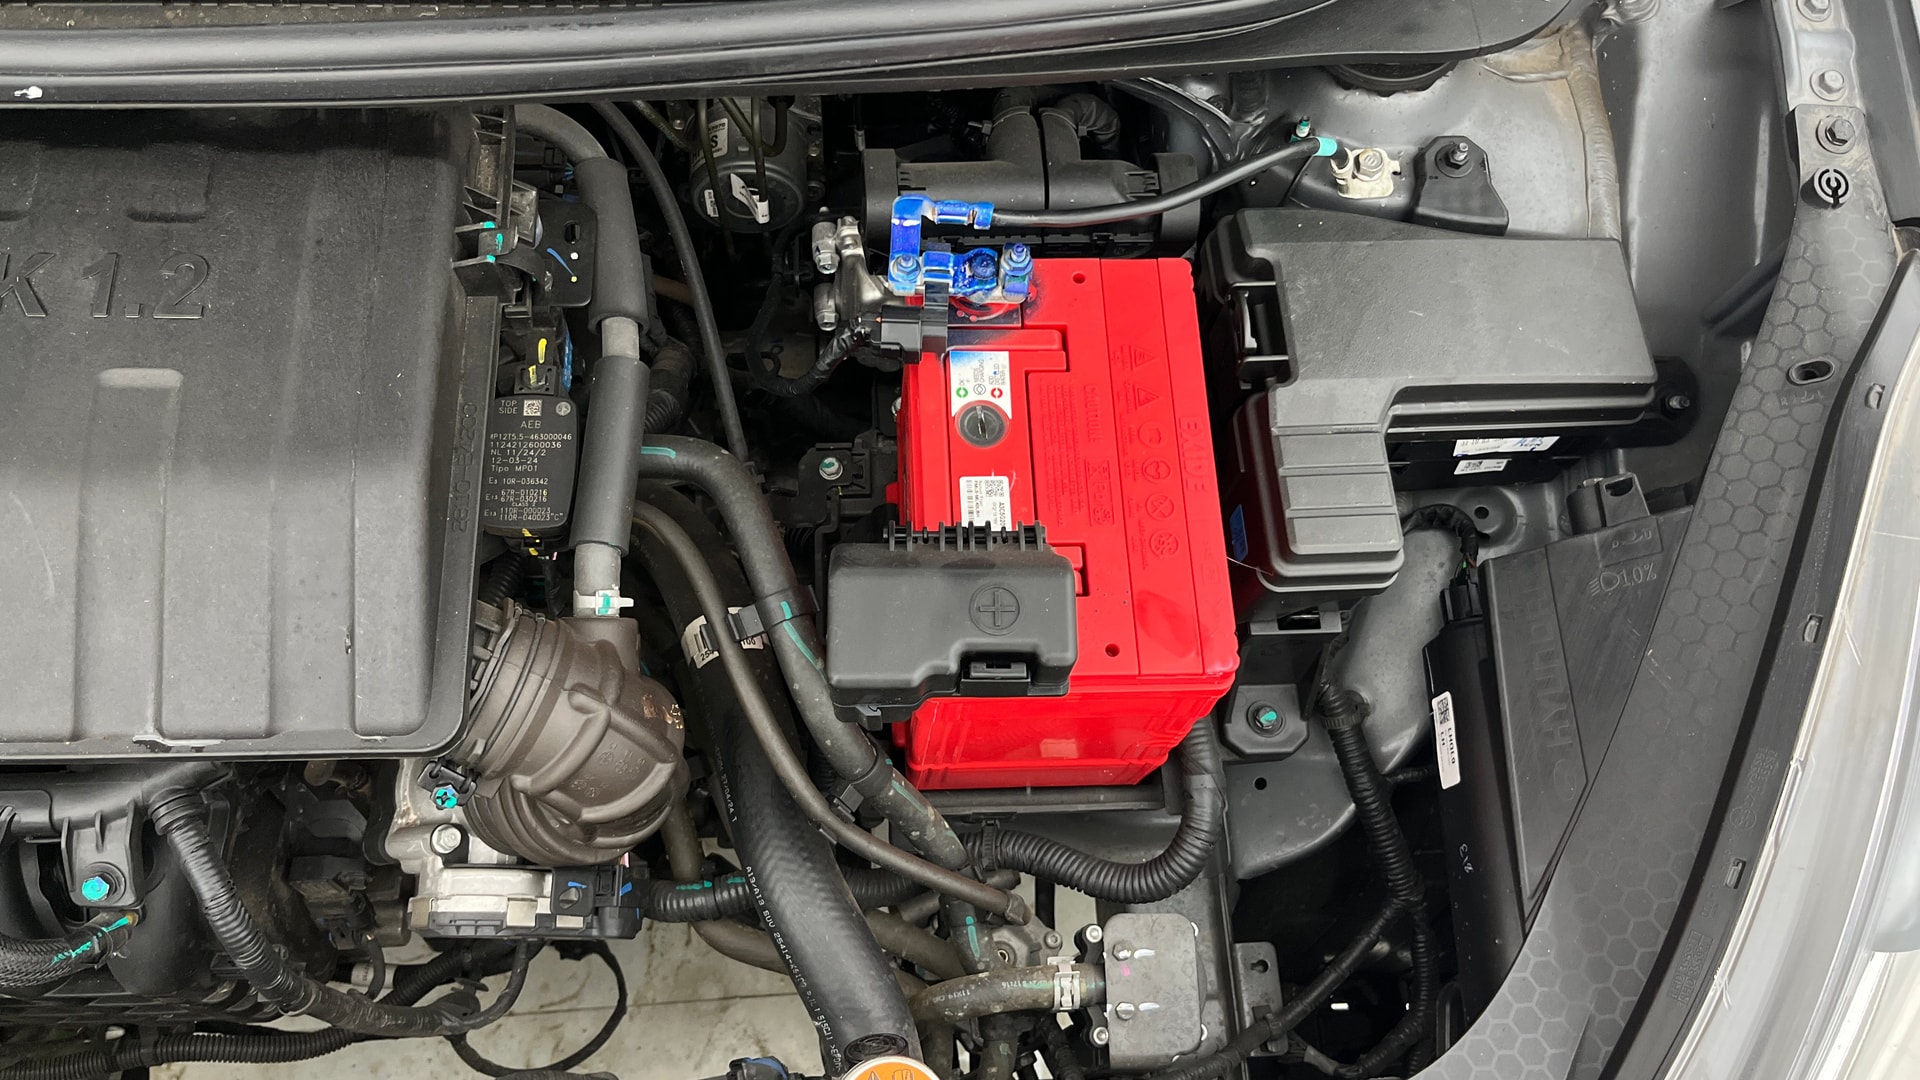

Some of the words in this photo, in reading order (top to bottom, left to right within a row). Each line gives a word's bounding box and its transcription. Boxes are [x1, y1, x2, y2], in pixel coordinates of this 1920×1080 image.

[82, 252, 210, 319] 1.2
[501, 399, 517, 407] TOP
[499, 407, 518, 415] SIDE
[520, 420, 541, 429] AEB
[1179, 416, 1208, 492] EXIDE
[491, 465, 509, 473] Tipo
